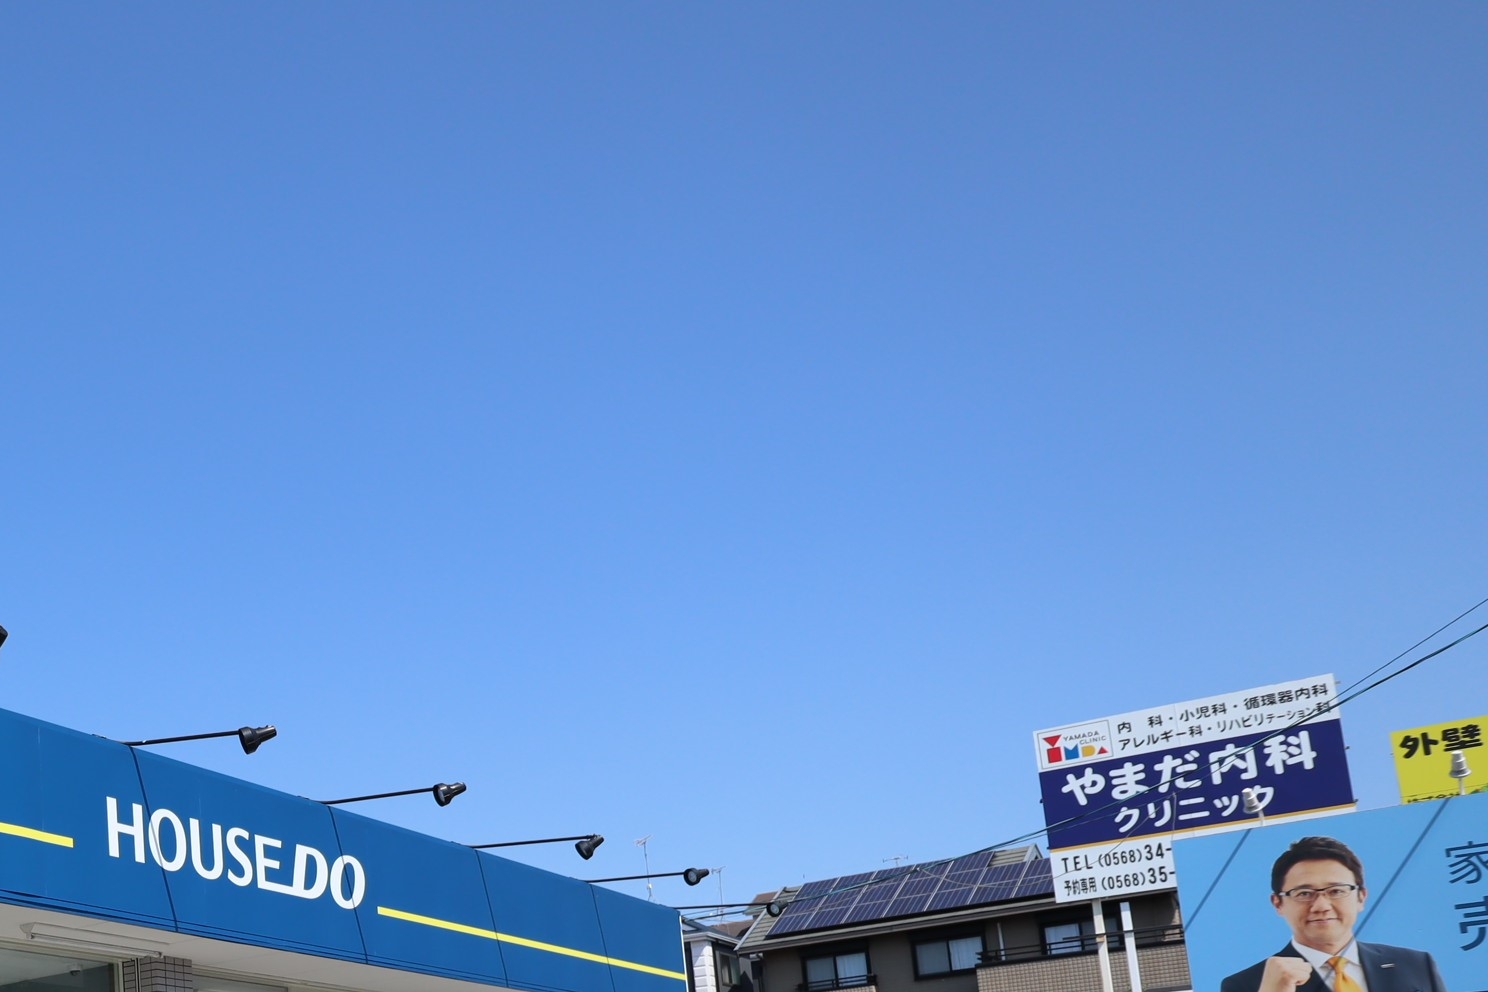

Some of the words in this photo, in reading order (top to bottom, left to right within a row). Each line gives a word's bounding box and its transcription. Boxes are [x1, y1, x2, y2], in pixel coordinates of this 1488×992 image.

[1062, 730, 1100, 742] YAMADA
[1079, 735, 1107, 746] CLINIC
[1399, 724, 1484, 759] 外壁
[1061, 730, 1318, 807] やまだ内科
[1061, 856, 1094, 874] TEL
[1064, 877, 1098, 897] 予約専用
